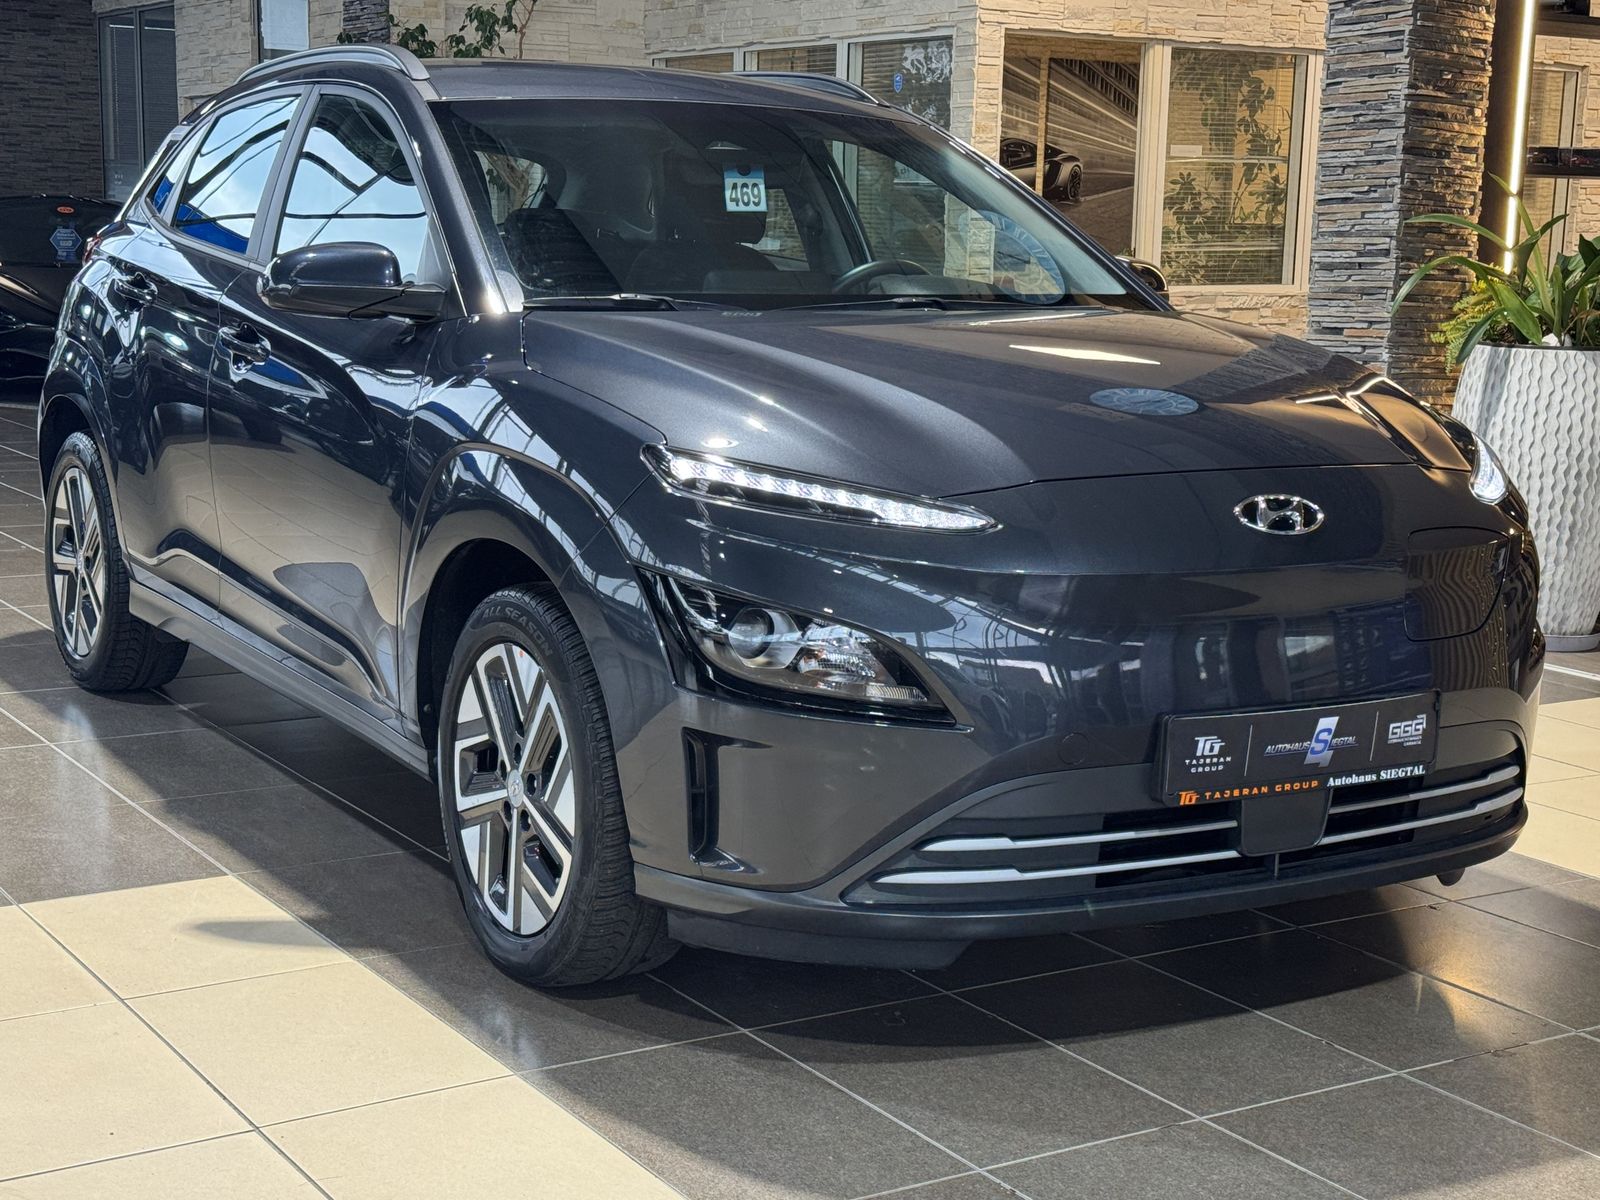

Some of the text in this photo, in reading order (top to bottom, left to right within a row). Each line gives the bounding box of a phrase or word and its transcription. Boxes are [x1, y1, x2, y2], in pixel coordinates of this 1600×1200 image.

[729, 182, 762, 207] 469
[482, 606, 553, 656] ALL SEASON
[1264, 741, 1311, 754] AUTOHAUS
[1184, 756, 1232, 765] TAJERAN
[1190, 765, 1224, 773] GROUP
[1327, 765, 1426, 787] Autohaus SIEGTAL
[1204, 786, 1269, 800] TAJERAN
[1275, 780, 1319, 792] GROUP
